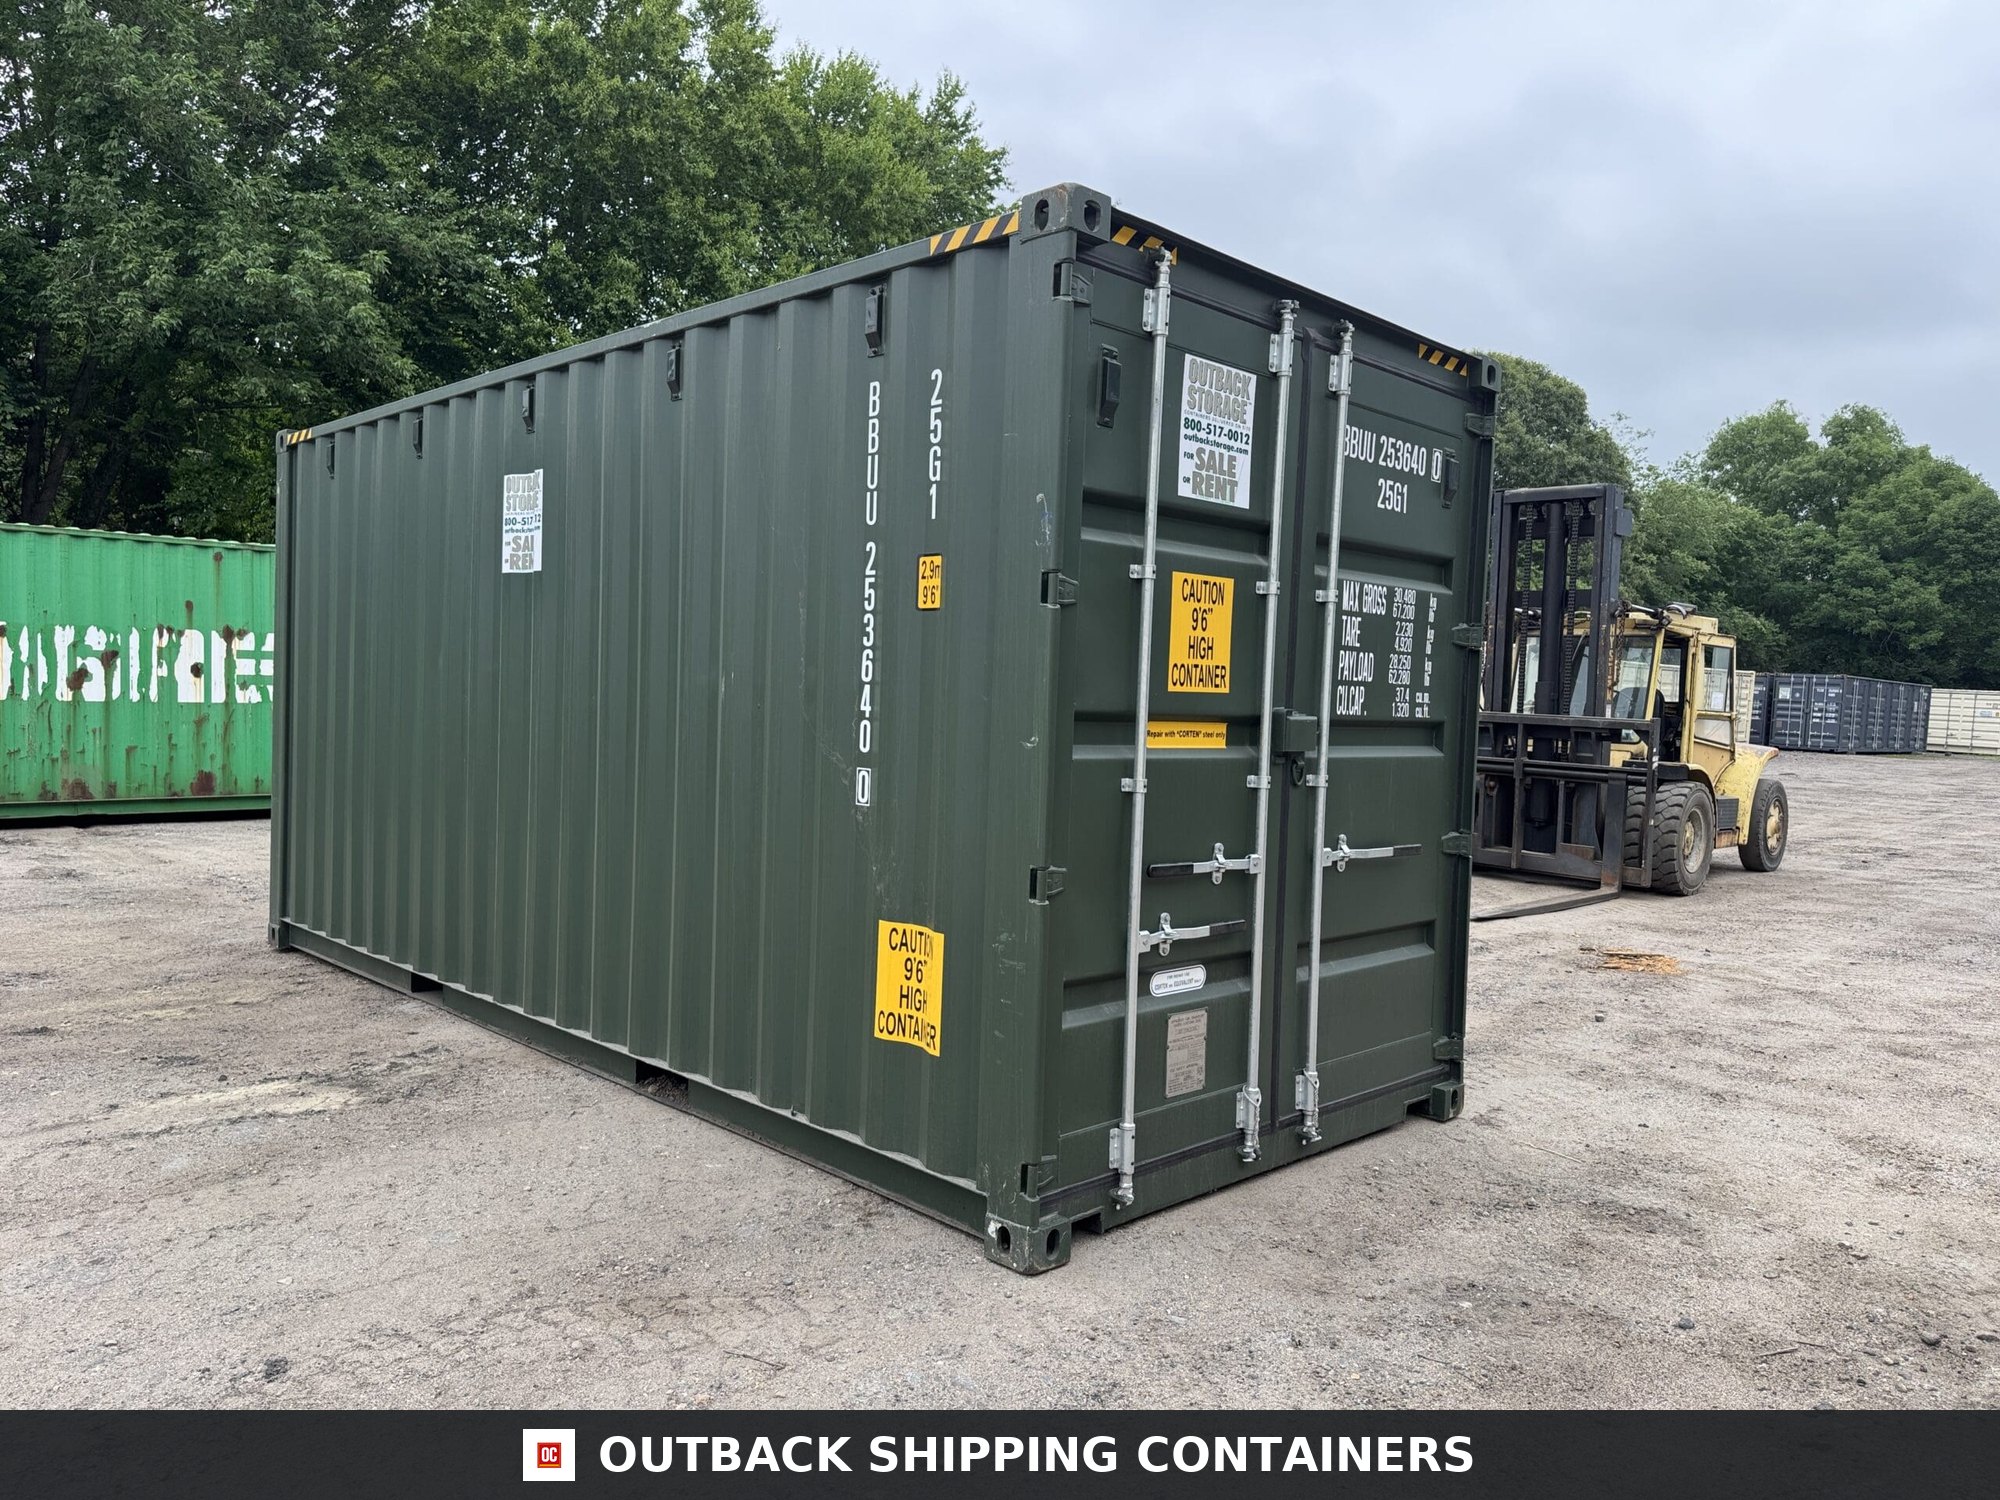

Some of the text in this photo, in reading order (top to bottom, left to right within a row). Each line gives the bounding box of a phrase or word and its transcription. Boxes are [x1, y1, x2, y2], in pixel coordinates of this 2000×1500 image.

[1188, 358, 1252, 401] OUTBACK
[1187, 384, 1248, 424] STORAGE
[928, 368, 943, 520] 25G1
[1184, 416, 1250, 446] 800-517-0012
[1184, 433, 1249, 456] outbackstorage.com
[1184, 447, 1237, 479] FOR SALE
[1378, 435, 1427, 476] 253640
[1432, 450, 1442, 481] 0
[1182, 470, 1238, 503] OR RENT
[1377, 478, 1408, 514] 25G1
[856, 381, 880, 805] BBUU 253640 0
[1182, 578, 1226, 606] CAUTION
[1342, 580, 1360, 612] MAX
[1362, 583, 1387, 616] GROSS
[1188, 635, 1214, 660] HIGH
[1342, 615, 1362, 648] TARE
[1171, 663, 1227, 689] CONTAINER
[1338, 650, 1375, 682] PAYLOAD
[1146, 730, 1164, 740] Repair
[1164, 730, 1176, 738] with
[1216, 732, 1225, 740] only
